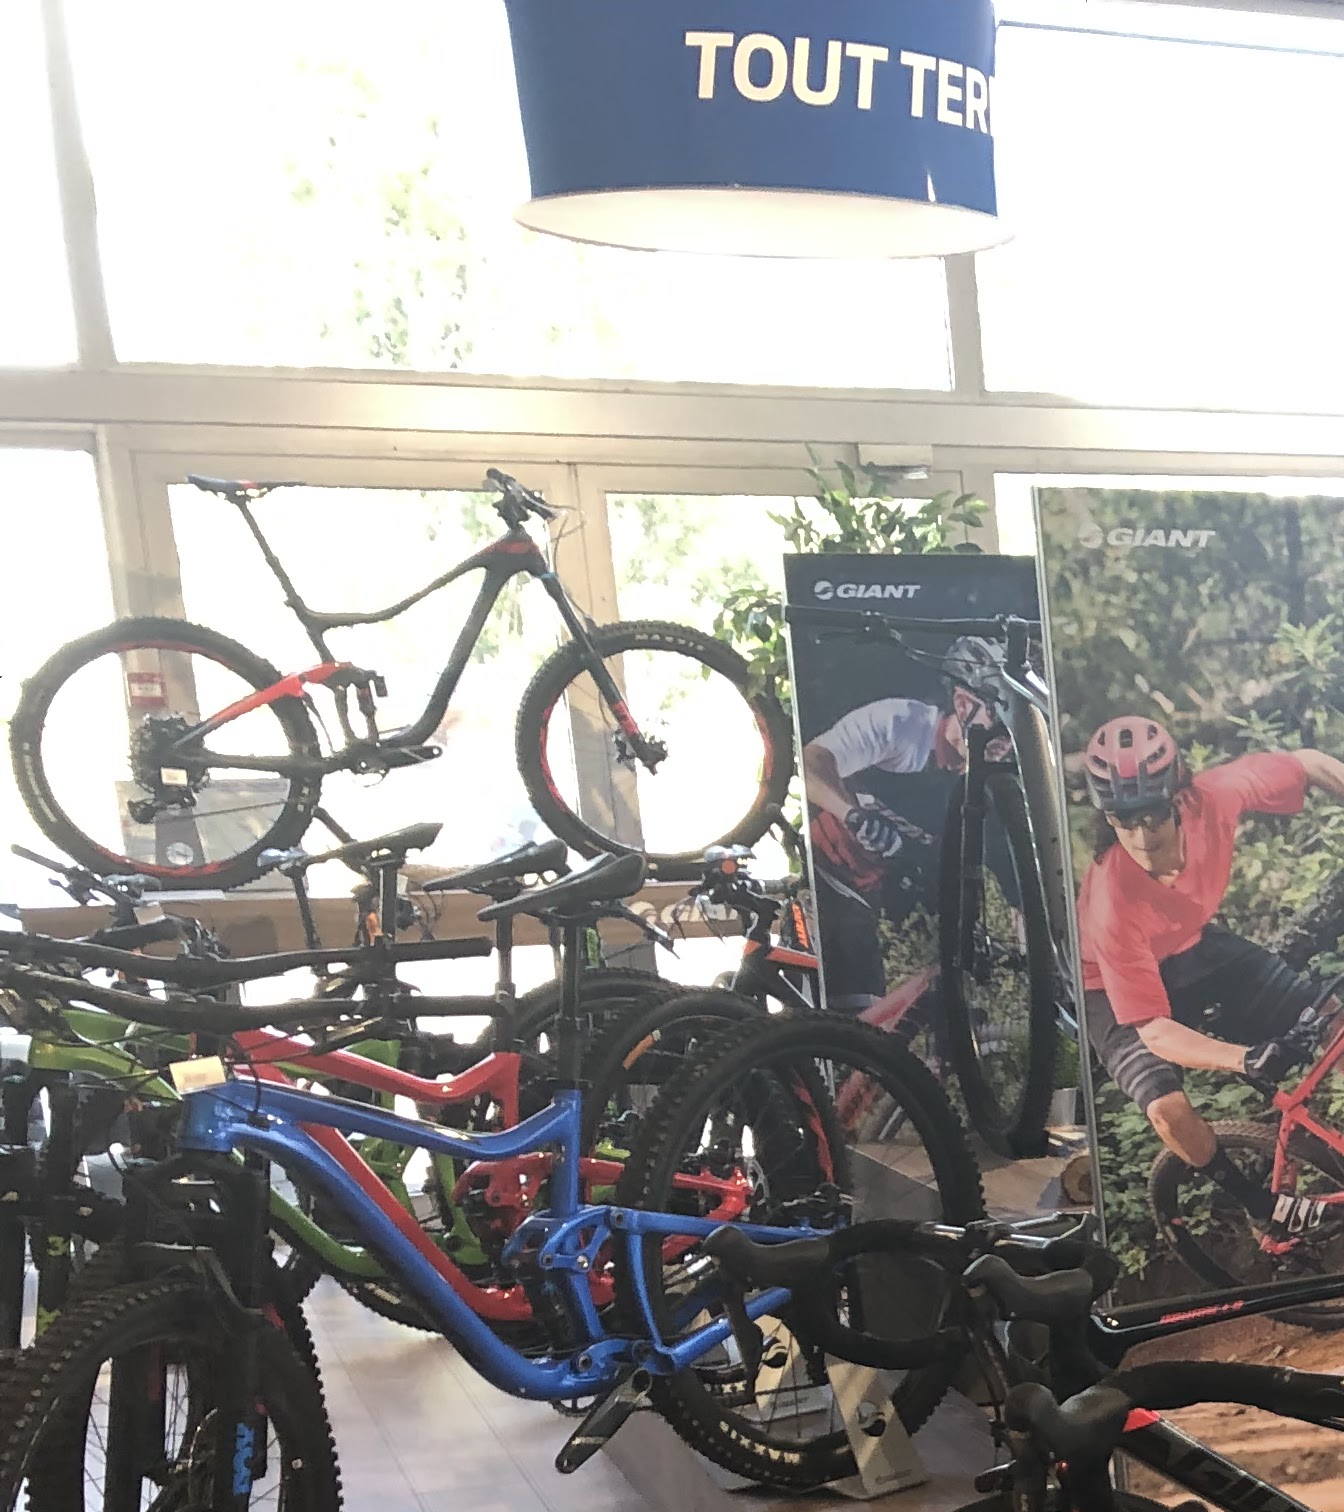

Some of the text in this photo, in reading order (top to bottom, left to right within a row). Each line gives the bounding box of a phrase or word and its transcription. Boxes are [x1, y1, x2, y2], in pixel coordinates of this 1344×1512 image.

[684, 31, 995, 136] TOUT TER
[1105, 528, 1216, 549] GIANT
[836, 583, 921, 599] GIANT
